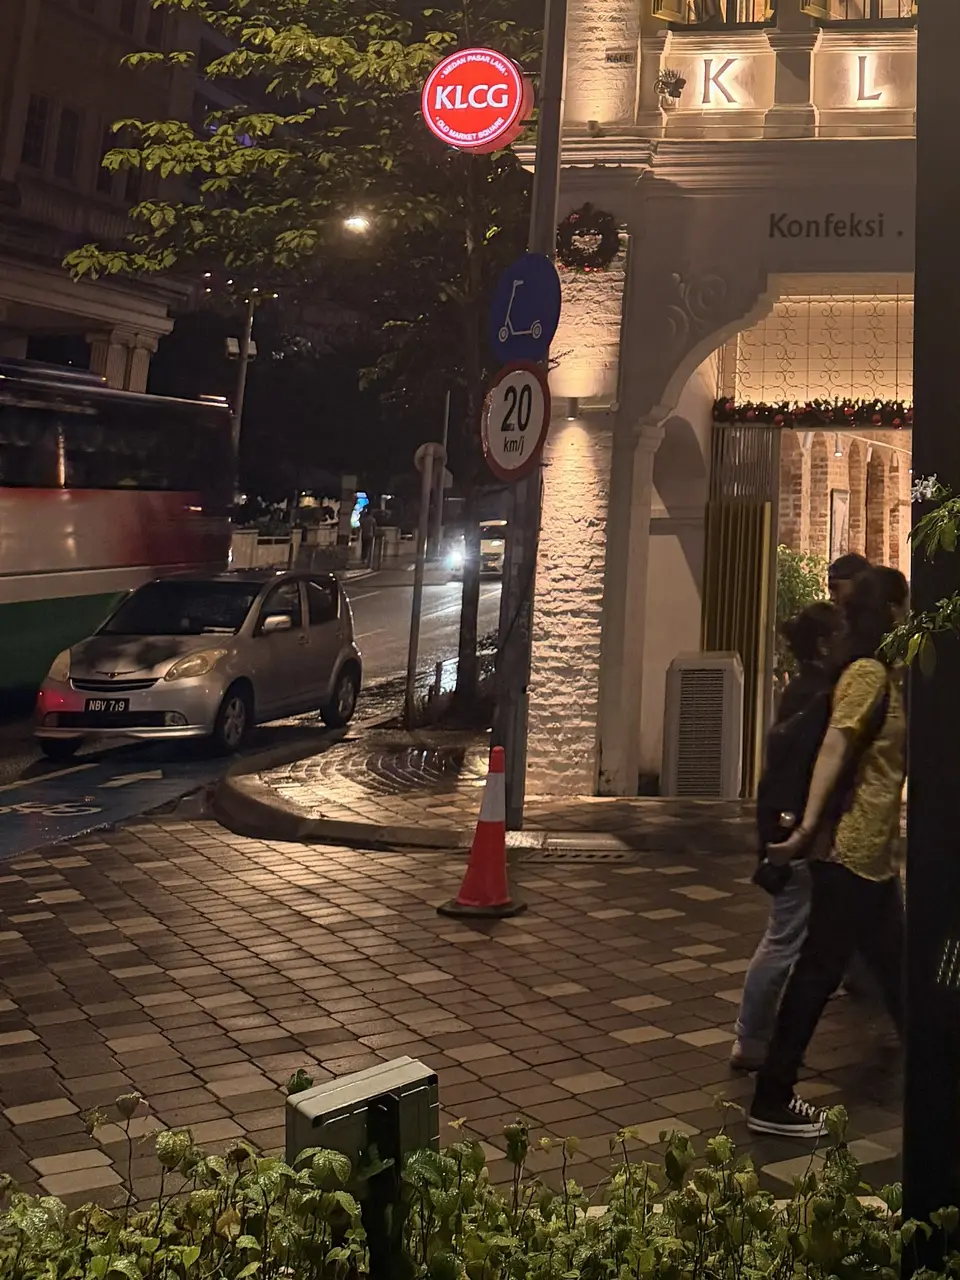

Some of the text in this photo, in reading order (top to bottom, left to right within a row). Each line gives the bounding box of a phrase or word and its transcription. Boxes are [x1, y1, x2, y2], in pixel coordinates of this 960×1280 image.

[443, 57, 467, 75] MEDAN
[467, 54, 491, 63] PASAR
[435, 83, 509, 110] KLCG
[437, 116, 505, 140] OLD MARKET SQUARE
[768, 212, 885, 239] Konfeksi
[501, 383, 533, 432] 20
[503, 435, 525, 456] km/j
[89, 700, 107, 711] NBV
